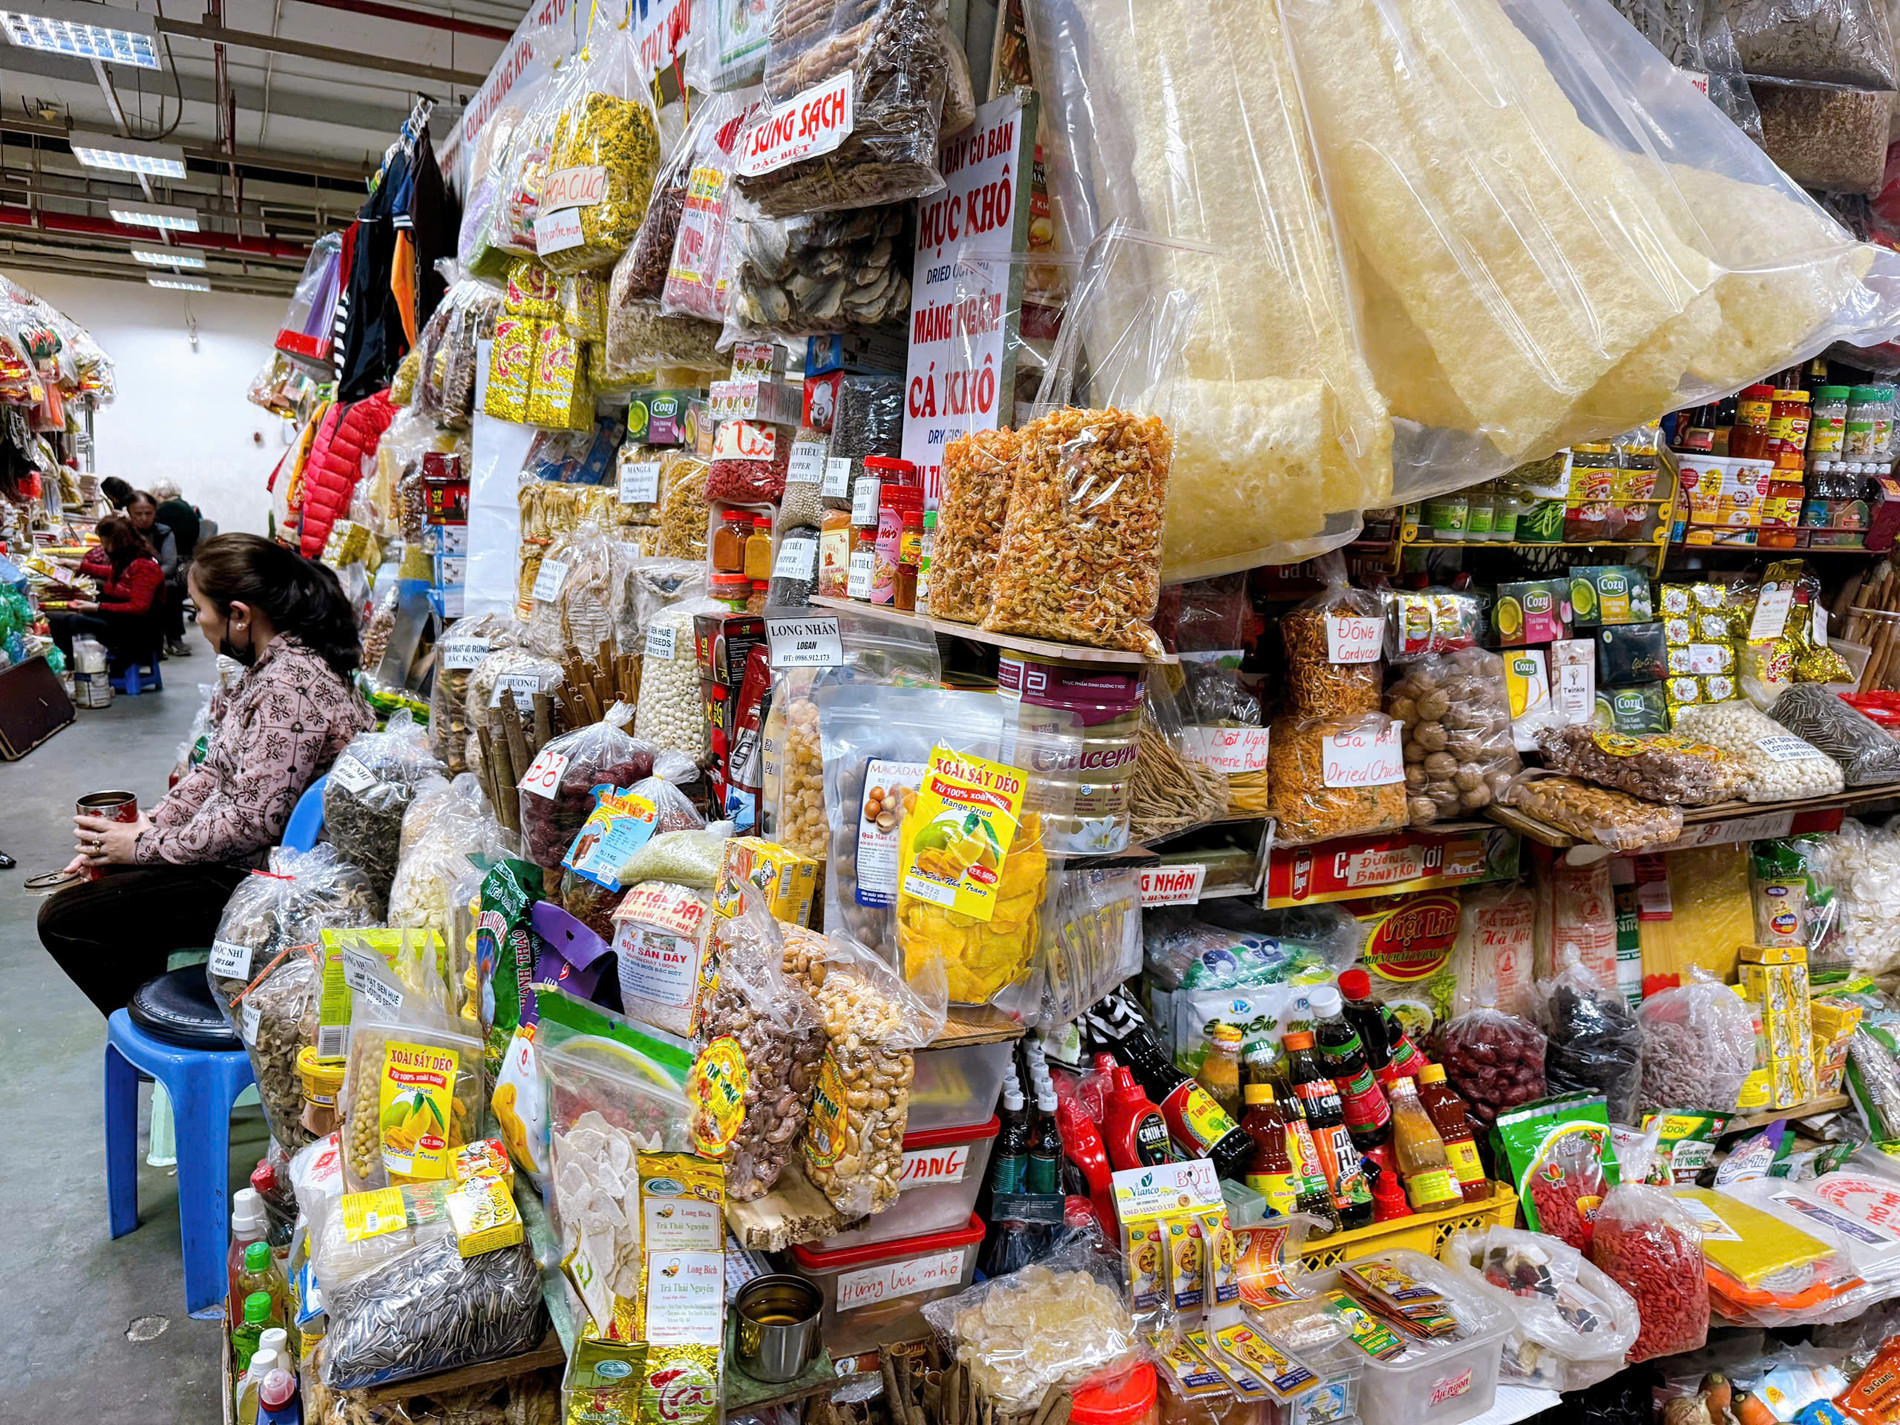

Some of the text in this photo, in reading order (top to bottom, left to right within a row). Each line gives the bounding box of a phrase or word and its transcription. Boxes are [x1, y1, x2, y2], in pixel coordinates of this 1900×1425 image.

[489, 64, 513, 116] HÀNG
[798, 88, 846, 143] SẠCH
[968, 126, 985, 167] CÓ
[986, 118, 1014, 159] BÁN
[917, 190, 961, 260] MỰC
[964, 162, 1012, 238] KHÔ
[926, 264, 951, 285] DRIED
[913, 288, 1002, 345] MĂNG NGÂM
[908, 352, 995, 419] CÁ KHÔ
[653, 401, 675, 415] Cozy
[927, 428, 945, 445] DRY
[858, 556, 873, 570] TIÊU
[849, 576, 866, 585] PEPPER
[1600, 577, 1624, 593] Cozy
[1525, 595, 1549, 610] Cozy
[770, 621, 838, 638] LONG NHÃN
[1337, 618, 1375, 641] ĐÔNG
[652, 639, 672, 648] SEEDS
[796, 641, 817, 651] LOGAN
[783, 653, 830, 662] ĐT: 0986.912.173
[1513, 660, 1536, 676] Cozy
[1563, 686, 1586, 695] Twinkle
[1617, 696, 1642, 712] Cozy
[1766, 743, 1793, 754] LOTUS
[934, 756, 1020, 795] XOÀI SẤY DẺO
[1326, 761, 1371, 783] Dried
[944, 785, 969, 799] 100%
[969, 805, 994, 818] Dried
[1295, 860, 1311, 875] Nam
[1154, 869, 1196, 893] NHÃN
[964, 882, 989, 897] Trang
[1382, 910, 1424, 947] Việt
[1481, 928, 1507, 946] Hà
[228, 945, 244, 959] NHĨ
[621, 938, 688, 964] BỘT SẮN DÂY
[1362, 948, 1386, 965] MIẾN
[366, 974, 402, 1006] HẠT SEN HUẾ
[389, 1047, 454, 1072] XOÀI SẤY DẺO
[399, 1072, 416, 1082] 100%
[416, 1086, 434, 1095] Dried
[1660, 1124, 1688, 1135] COOK
[417, 1151, 439, 1162] Trang
[1174, 1163, 1211, 1189] BỘT
[1128, 1184, 1160, 1198] Vianco
[681, 1208, 713, 1220] Long Bích
[1139, 1205, 1164, 1214] VIANCO
[1163, 1203, 1177, 1211] LTD
[656, 1221, 710, 1232] Trà Thái Nguyên
[686, 1263, 718, 1277] Long Bích
[659, 1282, 715, 1295] Trà Thái Nguyên
